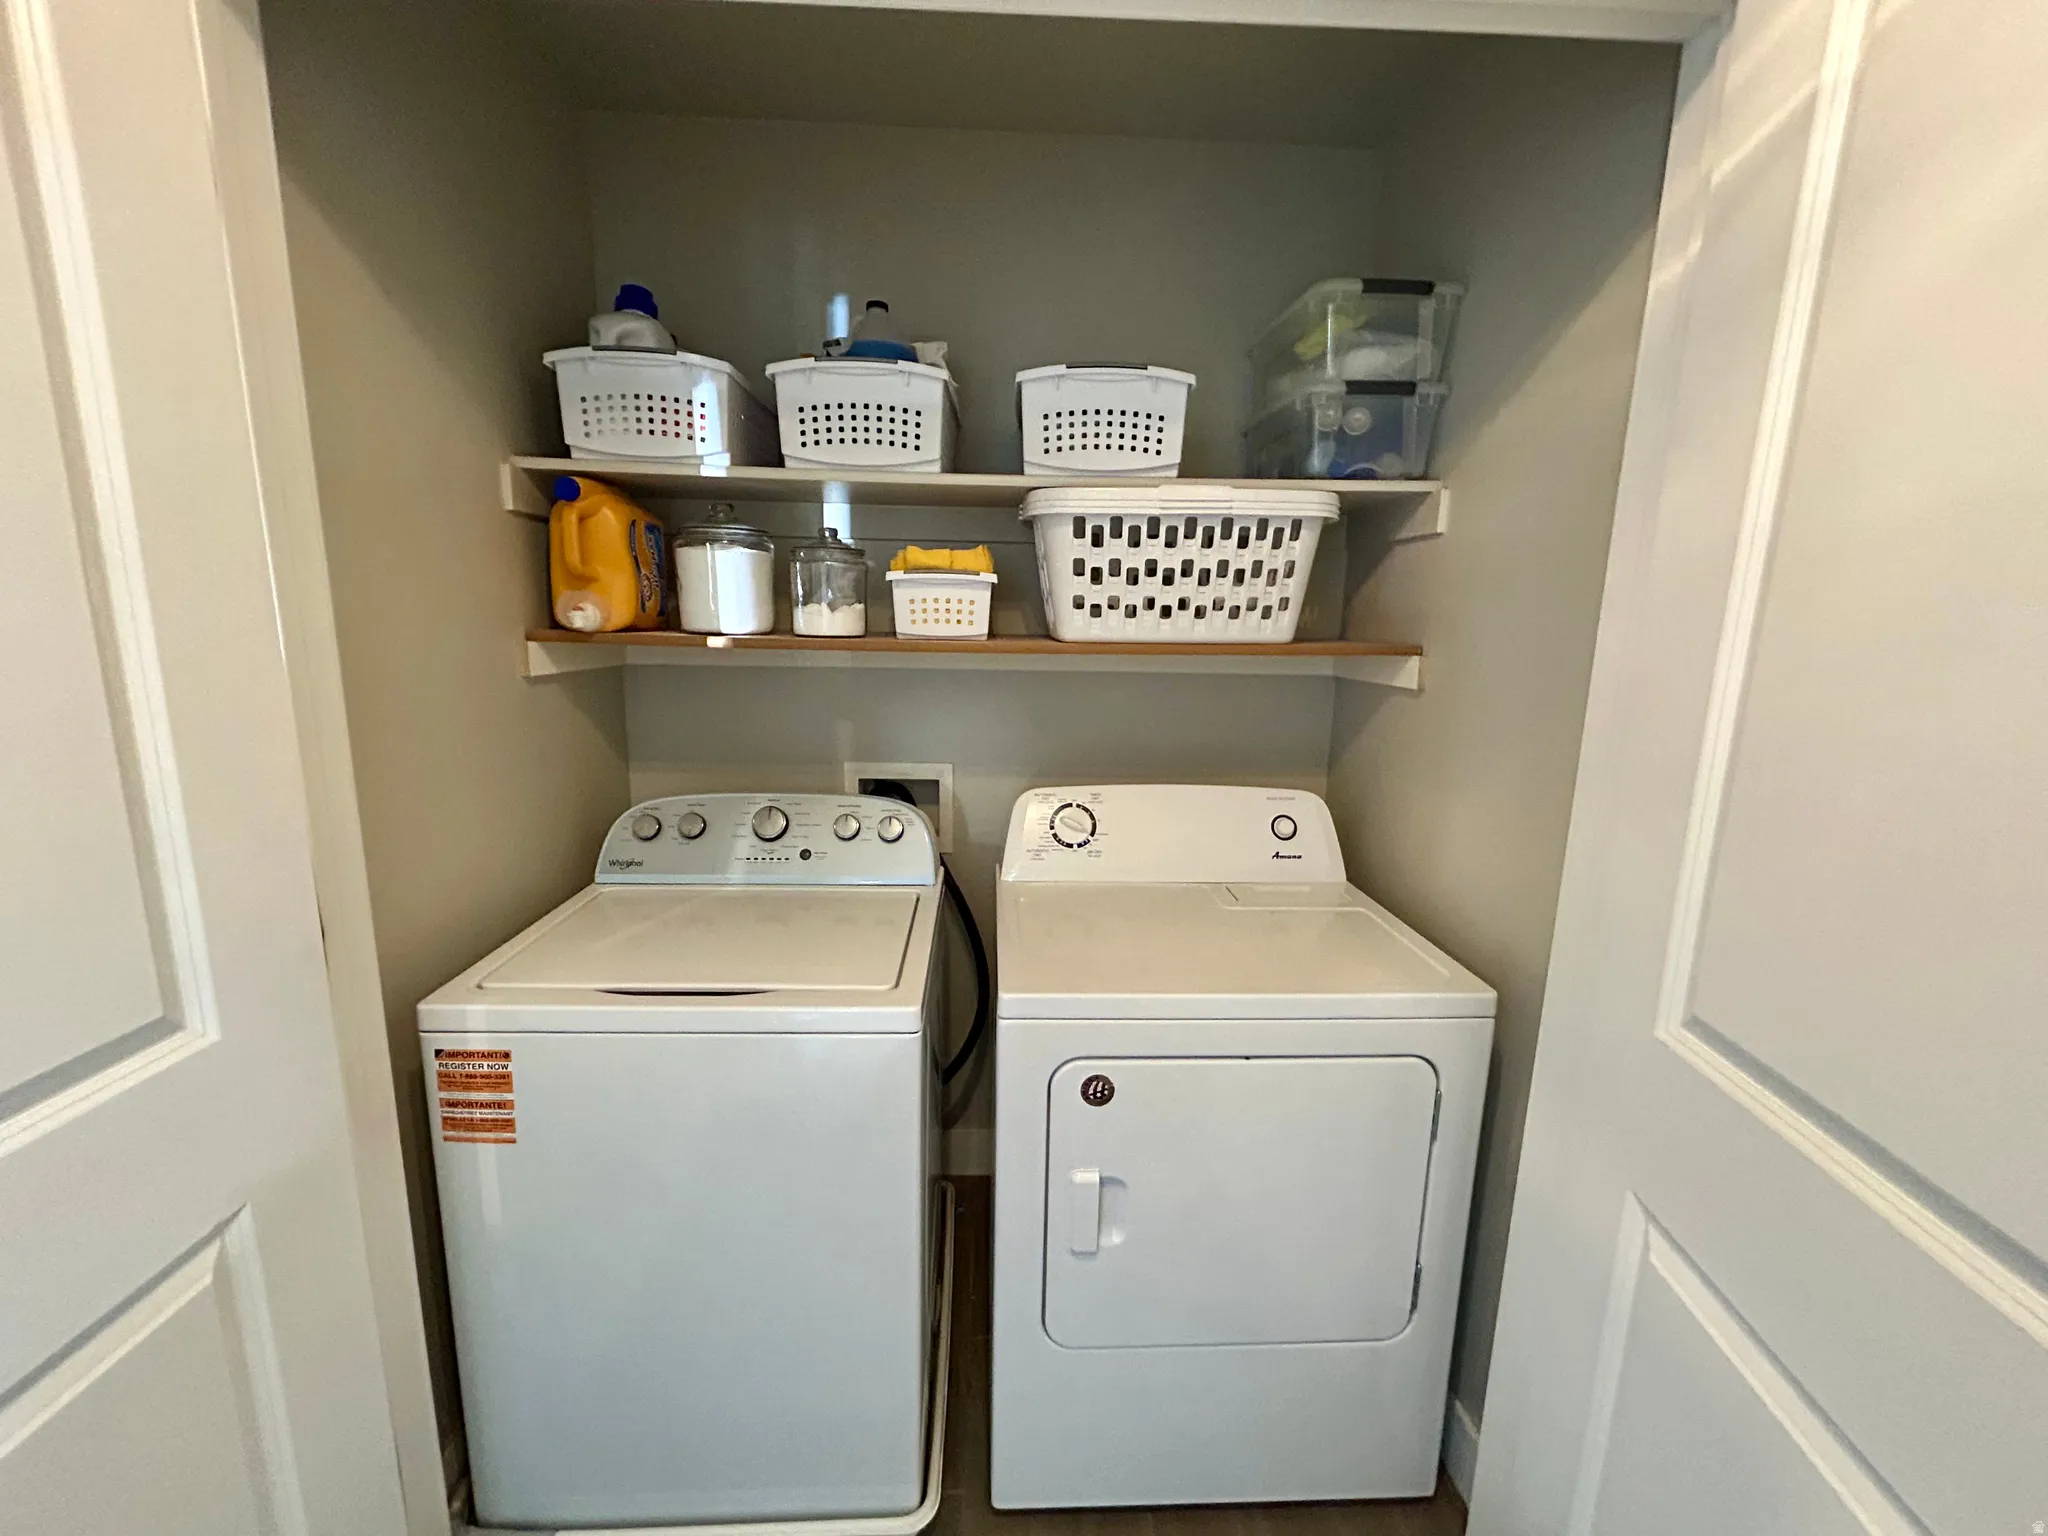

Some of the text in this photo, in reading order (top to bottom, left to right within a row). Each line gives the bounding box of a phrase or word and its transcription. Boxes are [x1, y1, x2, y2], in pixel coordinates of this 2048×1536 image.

[1272, 851, 1302, 859] Amana
[608, 858, 644, 870] Whirlpool
[438, 1062, 509, 1071] REGISTER NOW
